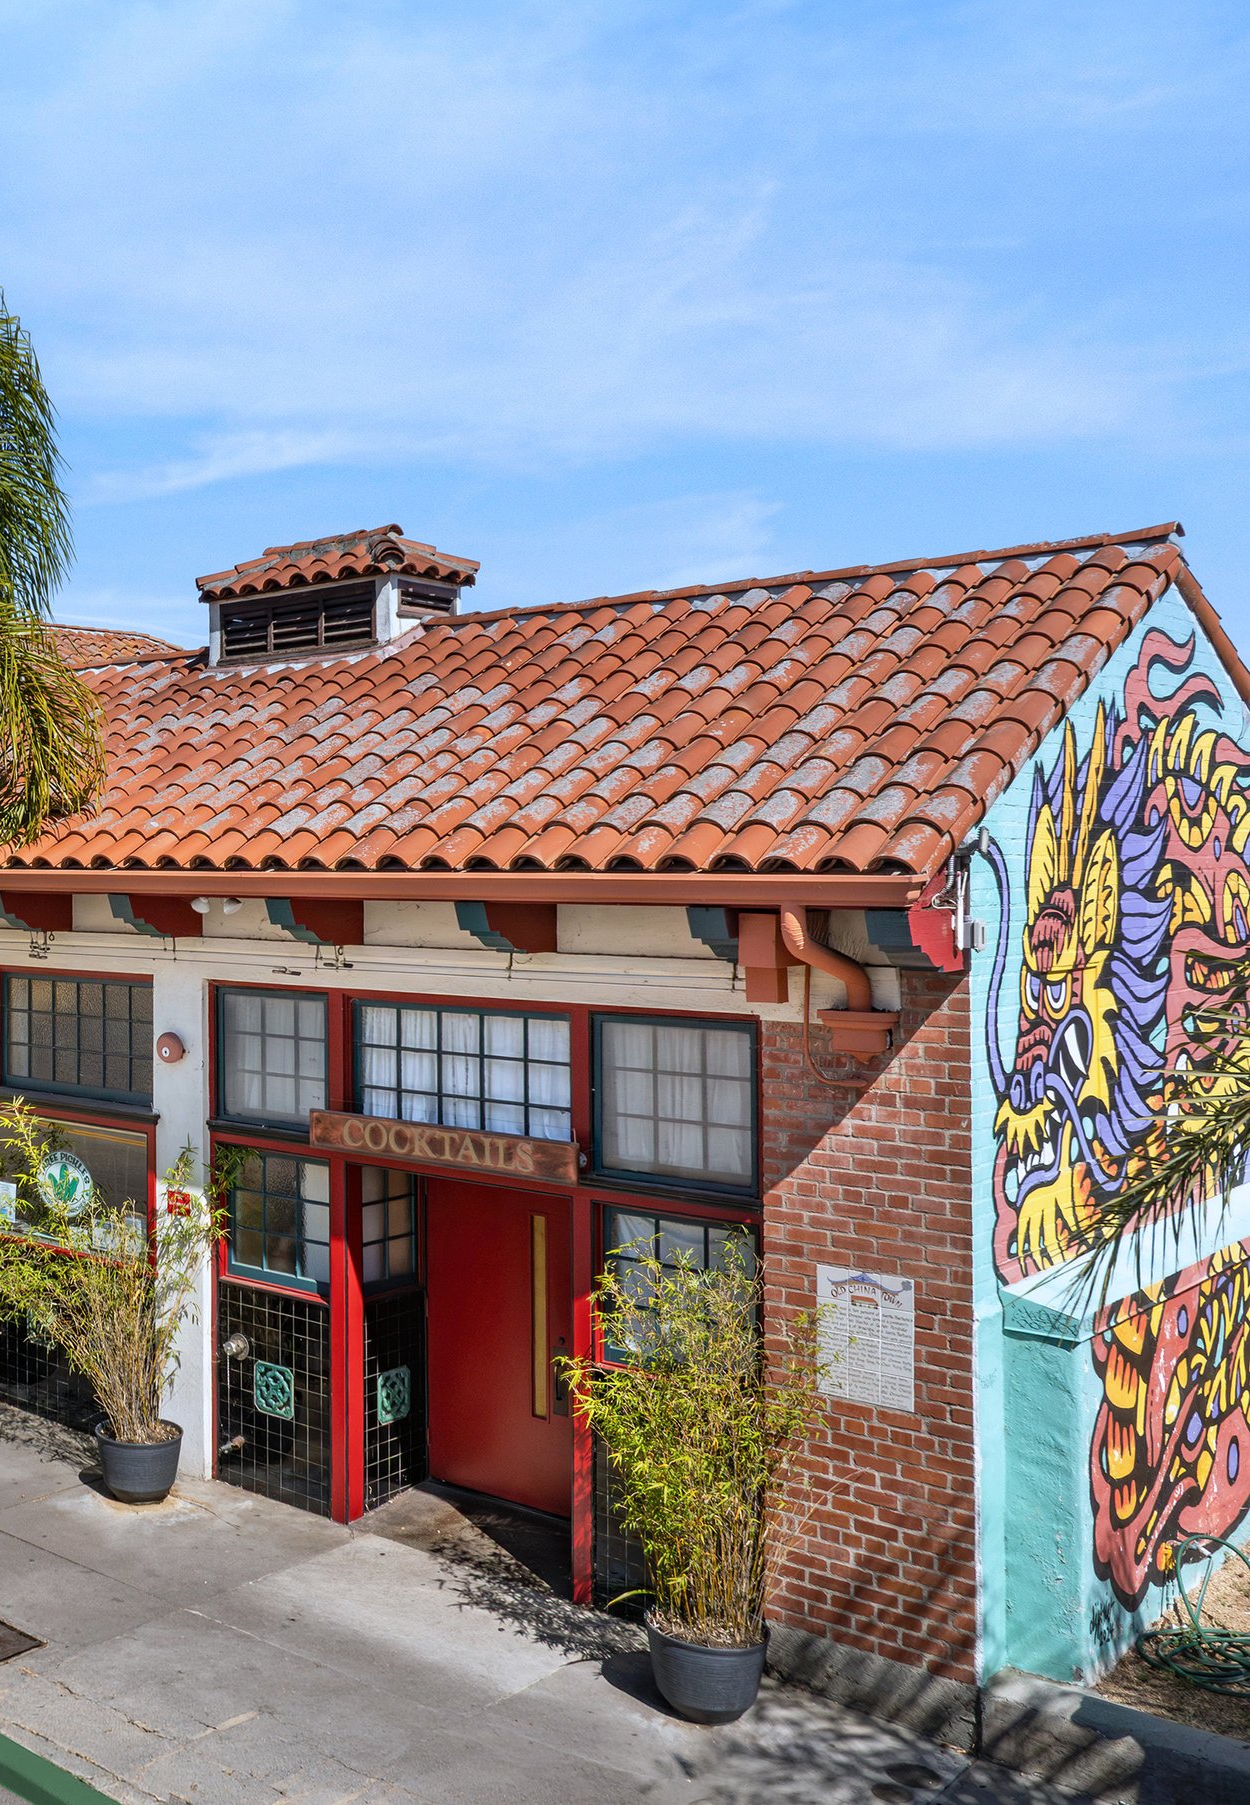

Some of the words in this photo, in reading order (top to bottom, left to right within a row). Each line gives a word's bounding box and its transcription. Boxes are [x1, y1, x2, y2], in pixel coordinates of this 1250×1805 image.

[342, 1118, 535, 1173] COCKTAILS
[60, 1152, 91, 1184] PICKLES
[830, 1285, 847, 1298] OLD
[848, 1285, 877, 1297] CHINA
